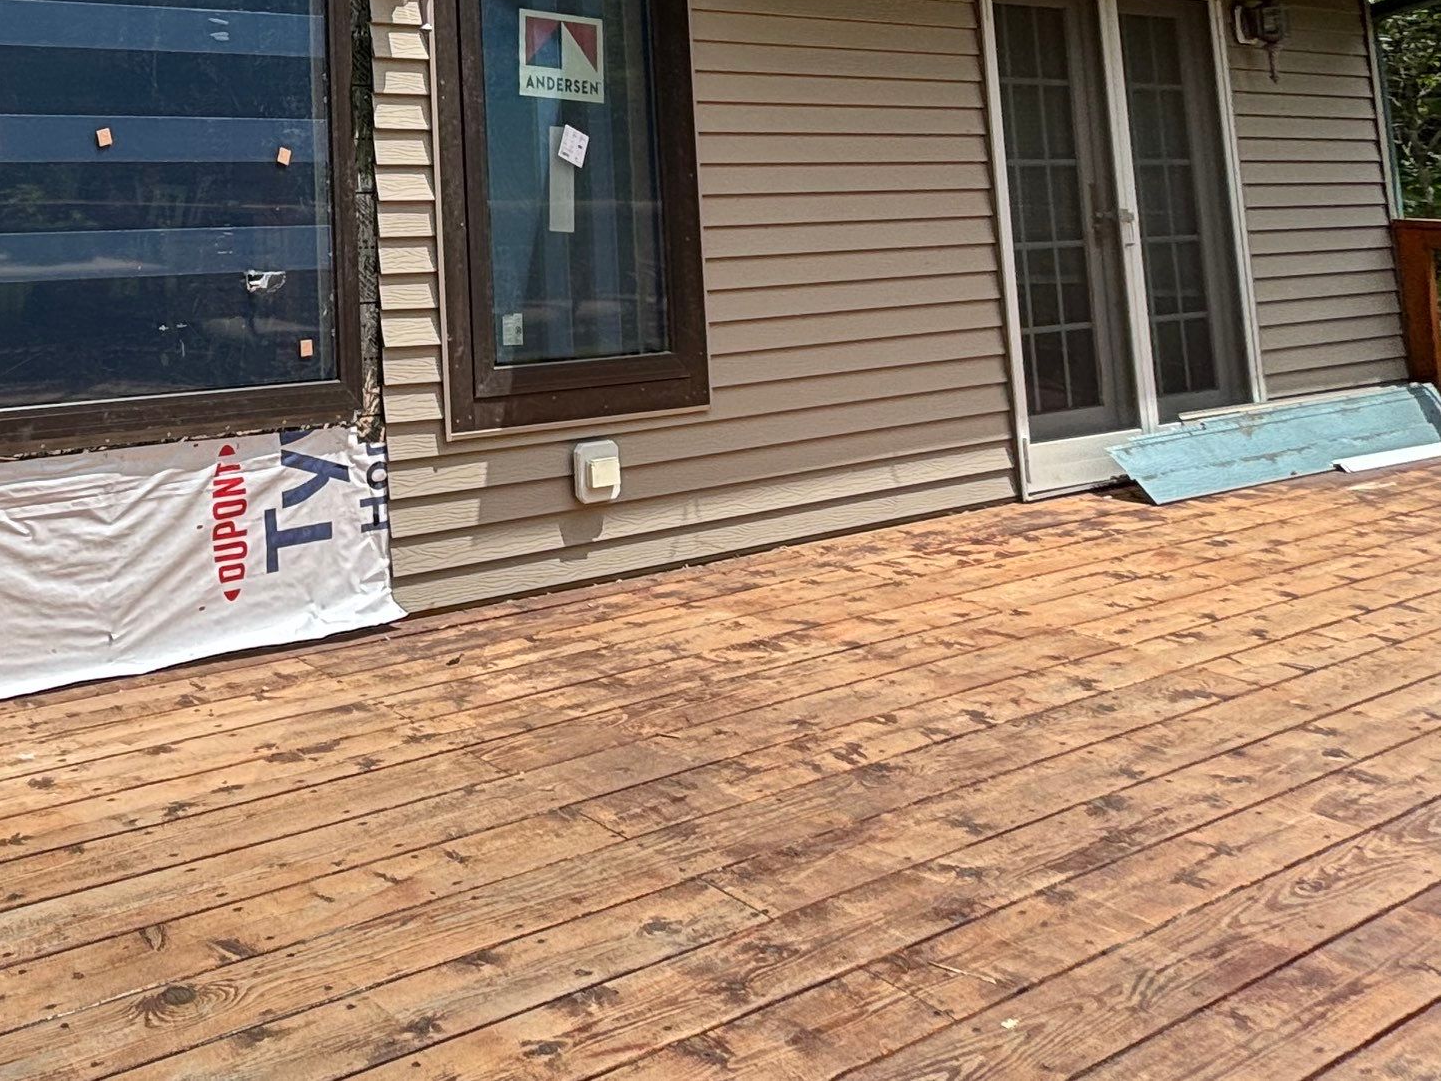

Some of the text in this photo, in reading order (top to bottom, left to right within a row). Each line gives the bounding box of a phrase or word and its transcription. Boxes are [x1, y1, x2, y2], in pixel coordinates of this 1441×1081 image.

[526, 75, 598, 95] ANDERSEN
[212, 462, 248, 584] DUPONT
[264, 430, 350, 574] Ty
